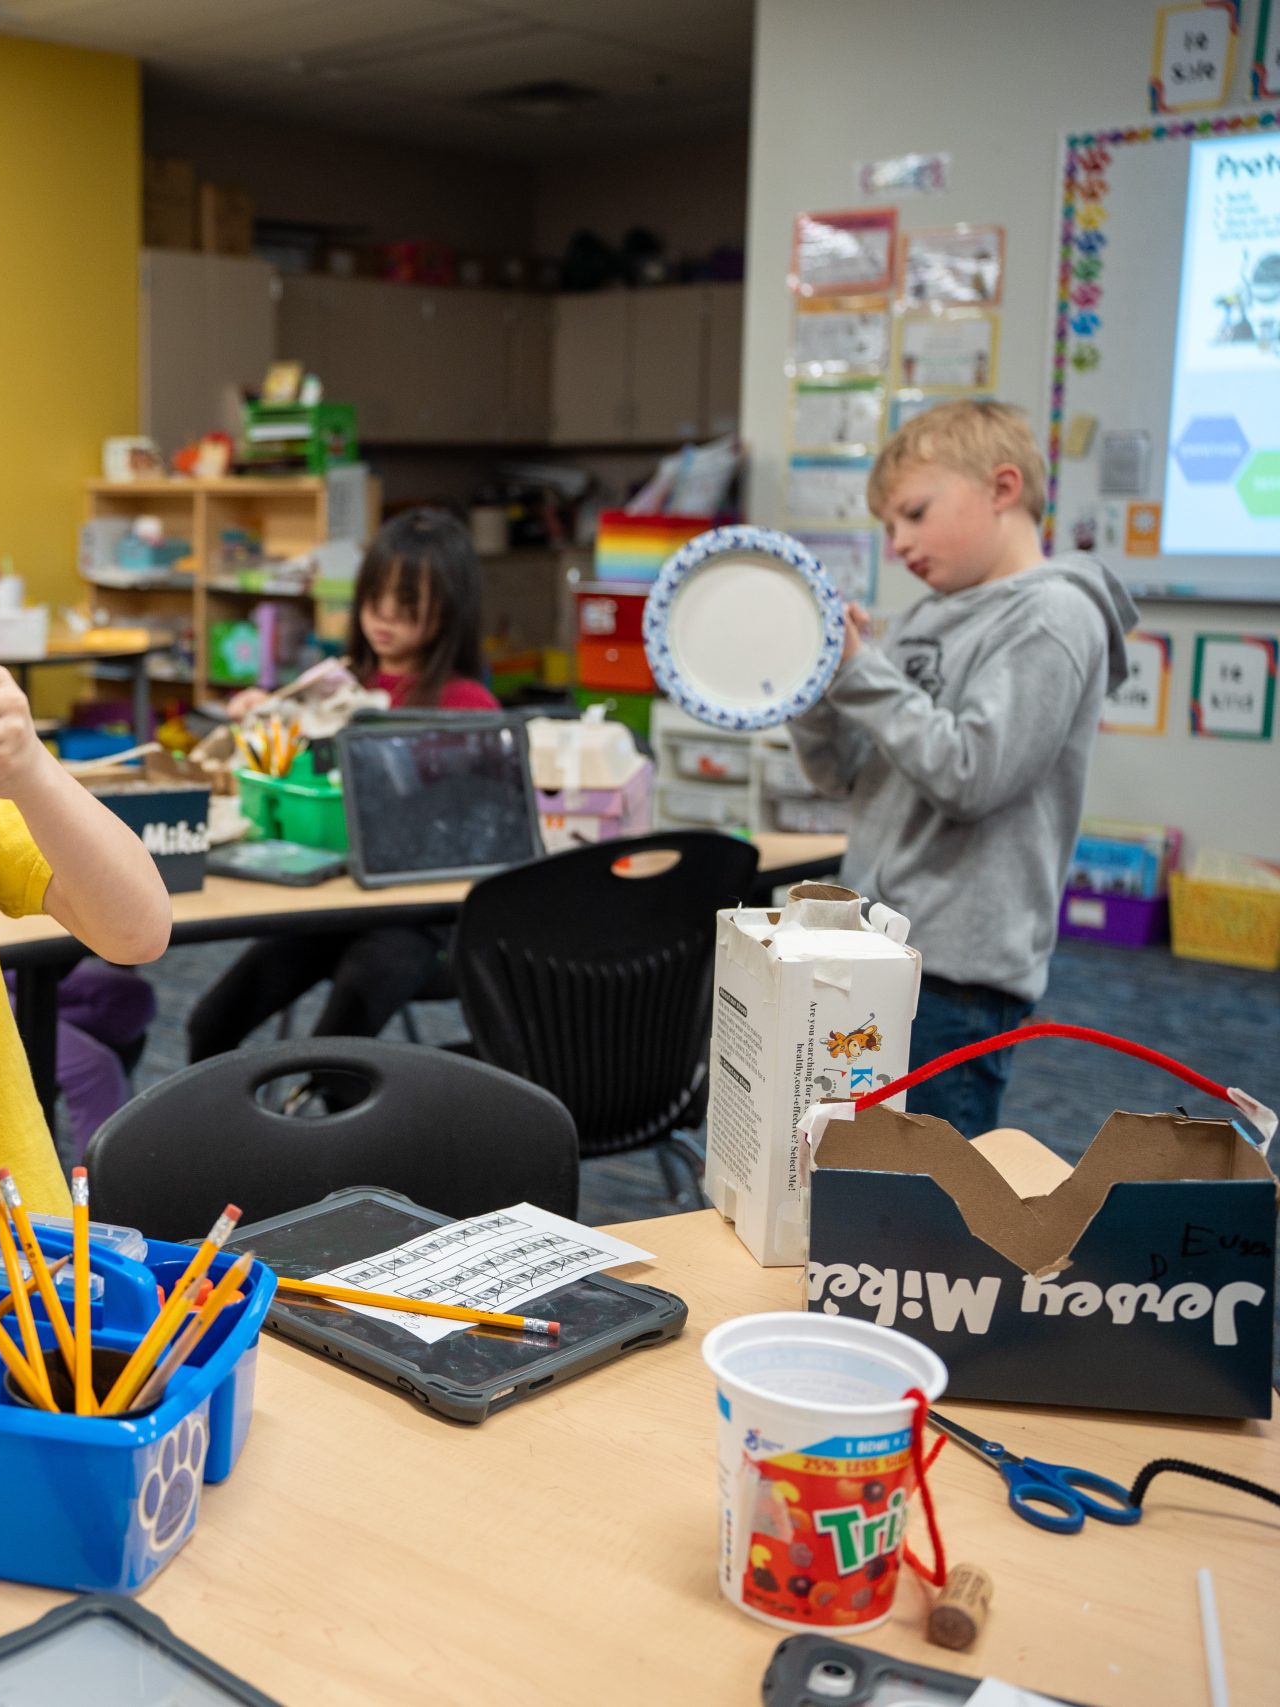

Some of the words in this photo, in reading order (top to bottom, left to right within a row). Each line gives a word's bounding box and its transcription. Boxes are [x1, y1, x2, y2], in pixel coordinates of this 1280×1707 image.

[809, 1000, 818, 1017] Are
[808, 1019, 816, 1036] you
[804, 1038, 815, 1082] searching
[805, 1084, 814, 1098] for
[789, 1146, 799, 1172] Select
[1022, 1271, 1266, 1346] Jersey
[803, 1456, 840, 1473] 25%
[813, 1487, 910, 1578] Tri
